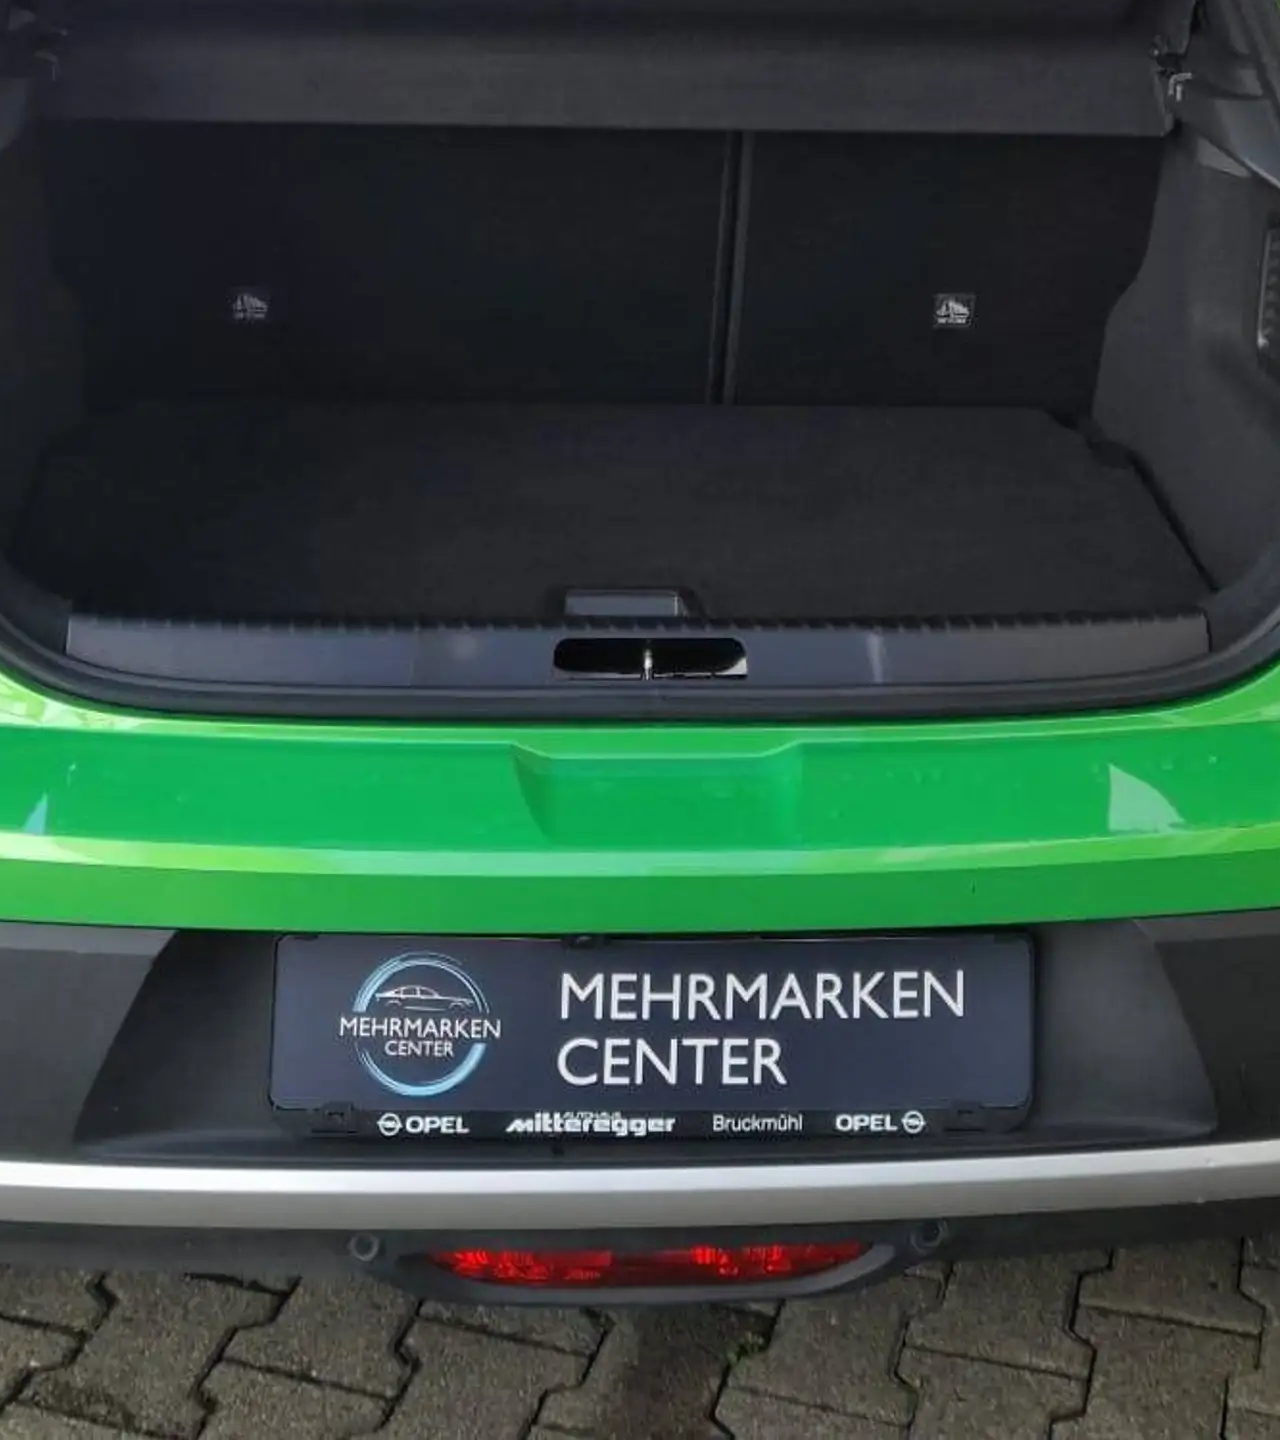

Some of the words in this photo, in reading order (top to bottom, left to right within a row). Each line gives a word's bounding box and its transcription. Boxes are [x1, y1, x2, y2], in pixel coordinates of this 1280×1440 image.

[560, 969, 965, 1021] MEHRMARKEN
[338, 1016, 502, 1040] MEHRMARKEN
[384, 1040, 455, 1058] CENTER
[556, 1037, 788, 1086] CENTER
[405, 1115, 470, 1134] OPEL
[712, 1113, 804, 1133] Bruckmühl
[835, 1114, 899, 1133] OPEL
